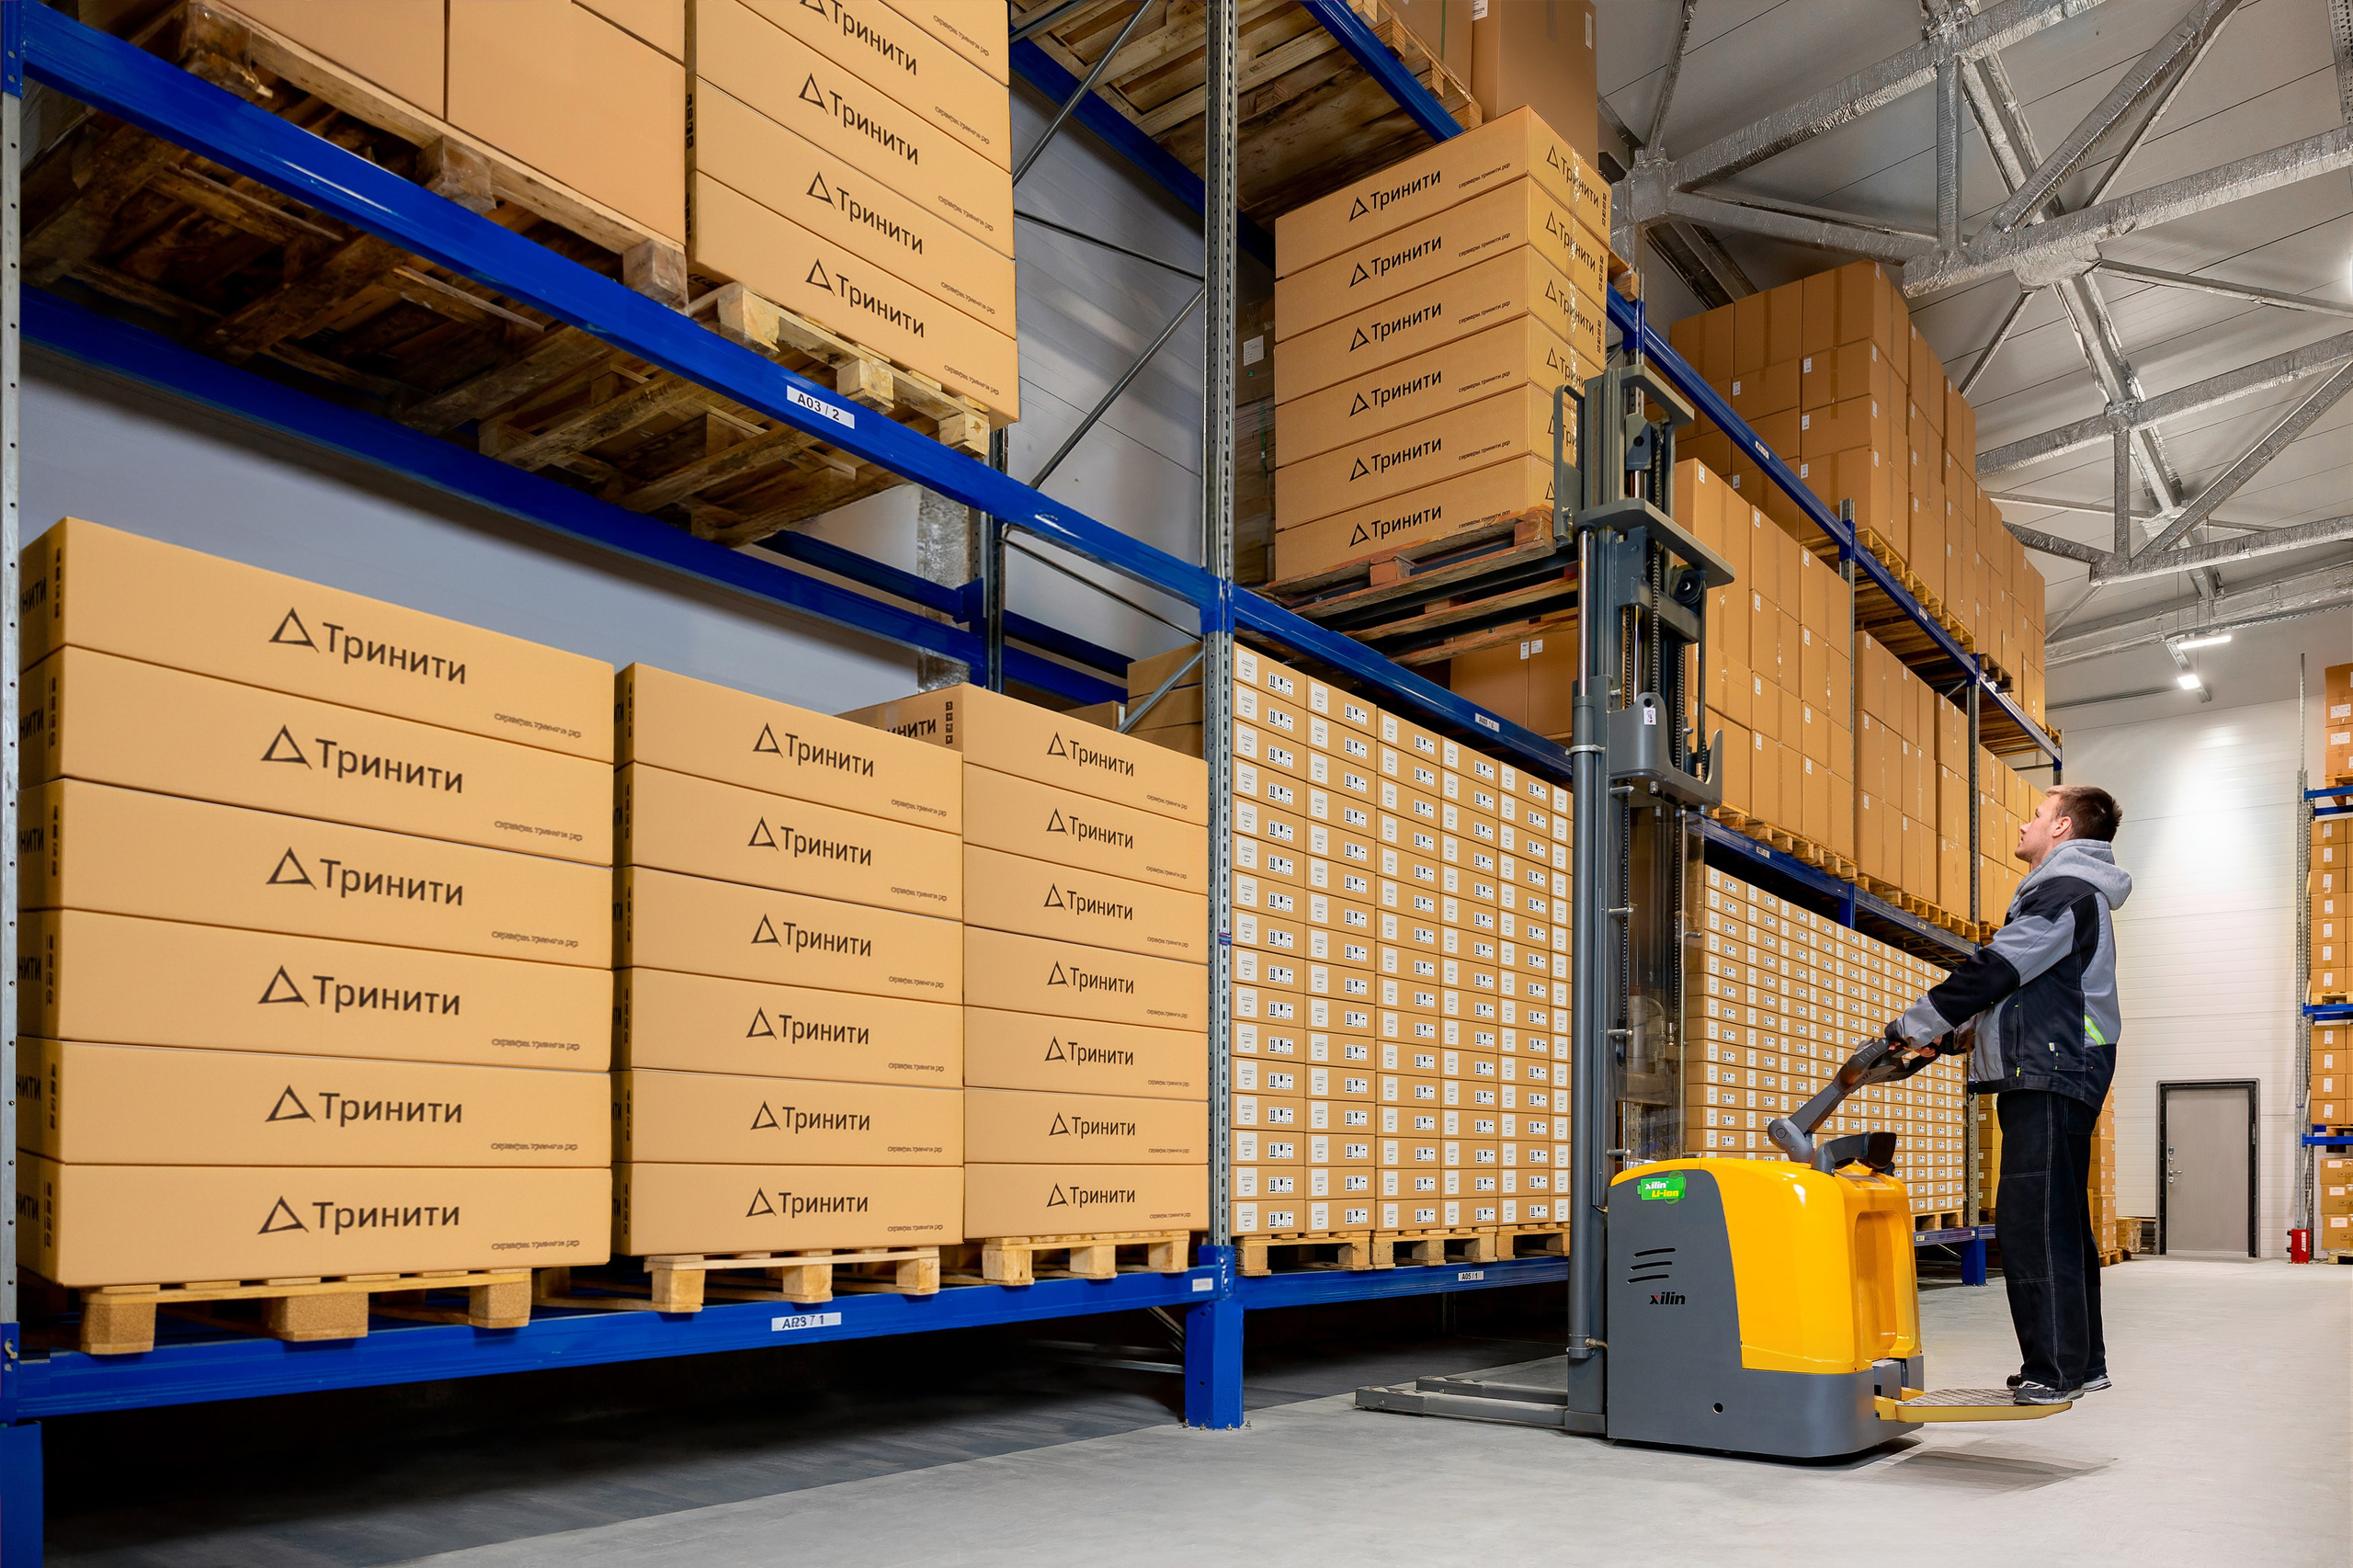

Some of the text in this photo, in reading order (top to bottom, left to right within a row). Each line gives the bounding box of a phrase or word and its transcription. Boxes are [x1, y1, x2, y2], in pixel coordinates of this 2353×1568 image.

[831, 0, 917, 75] Тринити
[829, 90, 918, 165] Тринити
[1370, 171, 1440, 210] Тринити
[836, 187, 924, 255] Тринити
[1371, 236, 1441, 277] Тринити
[836, 273, 924, 337] Тринити
[1371, 303, 1441, 342] Тринити
[1371, 370, 1441, 408] Тринити
[798, 393, 821, 412] A03
[832, 408, 839, 421] 2
[1371, 438, 1441, 473] Тринити
[1371, 506, 1441, 542] Тринити
[323, 622, 465, 684] Тринити
[884, 719, 936, 738] нити
[315, 738, 462, 793] Тринити
[785, 733, 873, 777] Тринити
[1070, 740, 1133, 777] Тринити
[780, 826, 871, 866] Тринити
[1069, 816, 1132, 848] Тринити
[320, 858, 462, 905] Тринити
[1067, 891, 1132, 920] Тринити
[783, 922, 870, 957] Тринити
[313, 975, 460, 1015] Тринити
[1070, 967, 1133, 994] Тринити
[779, 1015, 869, 1044] Тринити
[1068, 1042, 1133, 1065] Тринити
[319, 1093, 461, 1127] Тринити
[782, 1107, 870, 1134] Тринити
[1072, 1117, 1135, 1139] Тринити
[1070, 1187, 1134, 1208] Тринити
[1645, 1181, 1667, 1190] xilin
[313, 1202, 459, 1235] Тринити
[779, 1192, 868, 1218] Тринити
[1649, 1291, 1686, 1305] xilin
